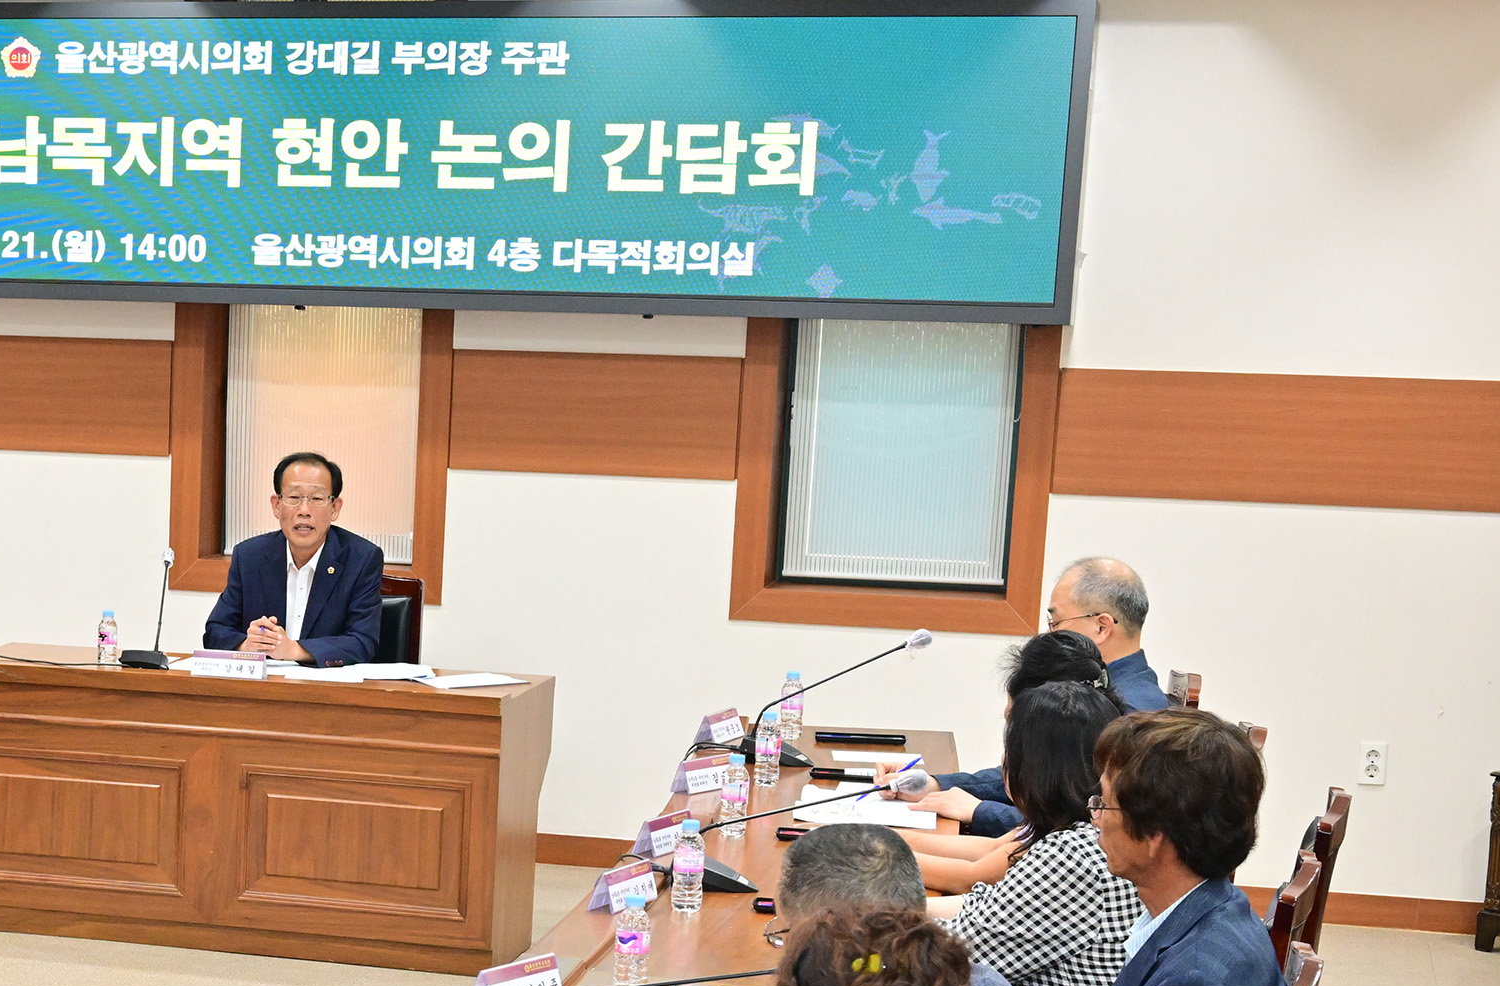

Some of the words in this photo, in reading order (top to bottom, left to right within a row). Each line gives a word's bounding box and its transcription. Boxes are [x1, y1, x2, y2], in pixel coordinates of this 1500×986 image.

[11, 53, 30, 63] 의회
[56, 40, 273, 75] 울산광역시의회
[286, 40, 381, 76] 강대길
[392, 40, 491, 76] 부의장
[502, 40, 570, 76] 주관
[272, 117, 409, 189] 현안
[431, 119, 571, 193] 논의
[601, 120, 819, 196] 간담회
[1, 229, 106, 263] 21.(월)
[120, 233, 207, 263] 14:00
[251, 233, 476, 271] 울산광역시의회
[487, 237, 541, 272] 4층
[552, 238, 756, 276] 다목적회의실
